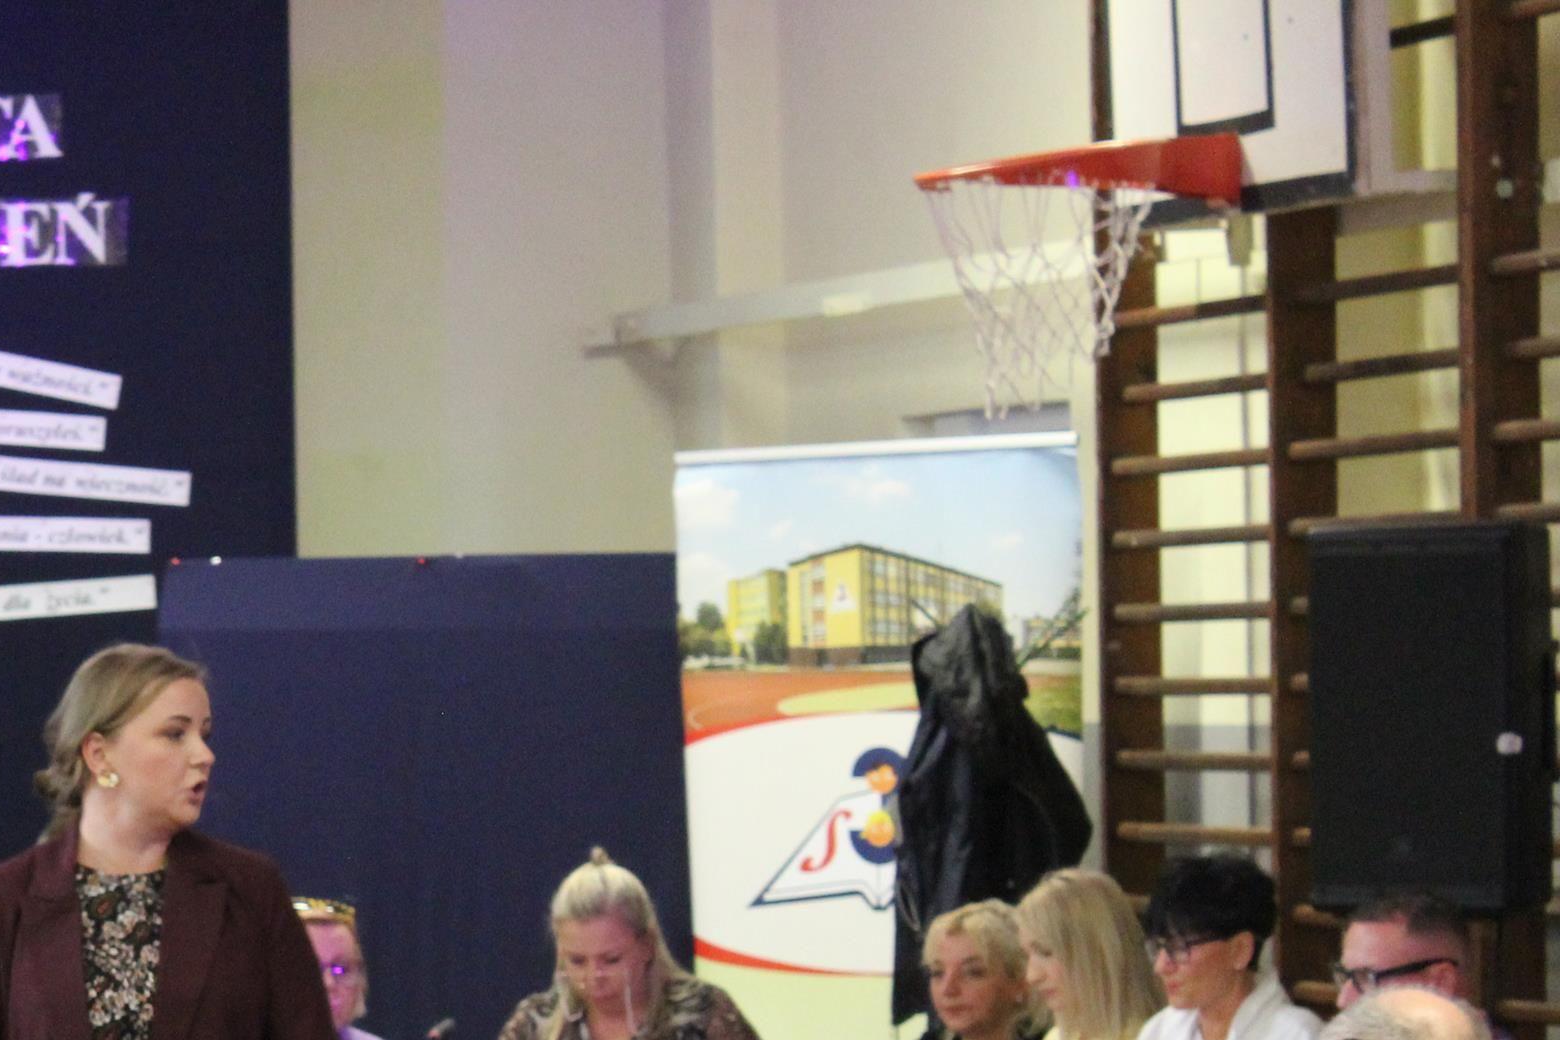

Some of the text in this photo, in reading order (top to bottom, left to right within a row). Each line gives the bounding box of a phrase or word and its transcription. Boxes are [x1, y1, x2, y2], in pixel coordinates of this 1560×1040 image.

[0, 463, 39, 485] ślad
[43, 473, 65, 487] na
[3, 594, 32, 611] dla
